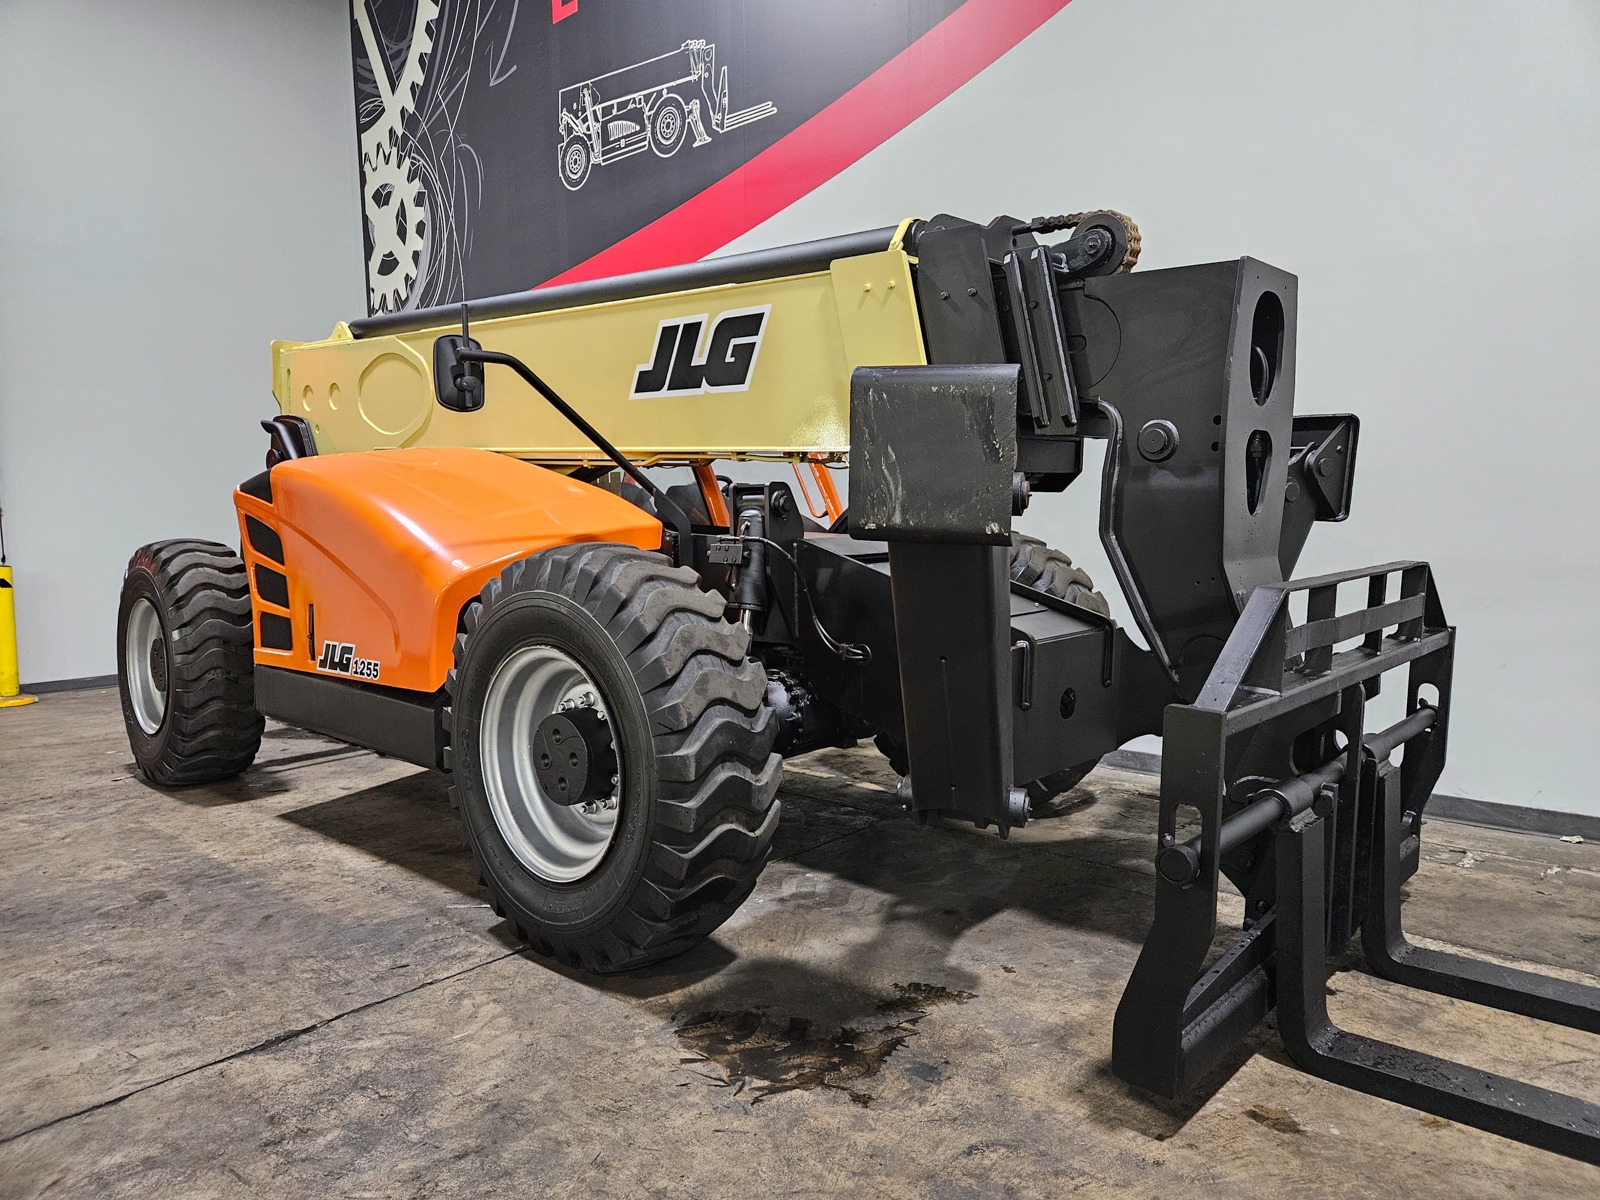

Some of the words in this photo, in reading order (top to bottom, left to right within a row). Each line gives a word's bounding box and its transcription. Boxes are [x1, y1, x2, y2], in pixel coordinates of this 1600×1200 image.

[631, 307, 769, 397] JLG
[318, 642, 354, 674] JLG
[353, 658, 379, 679] 1255
